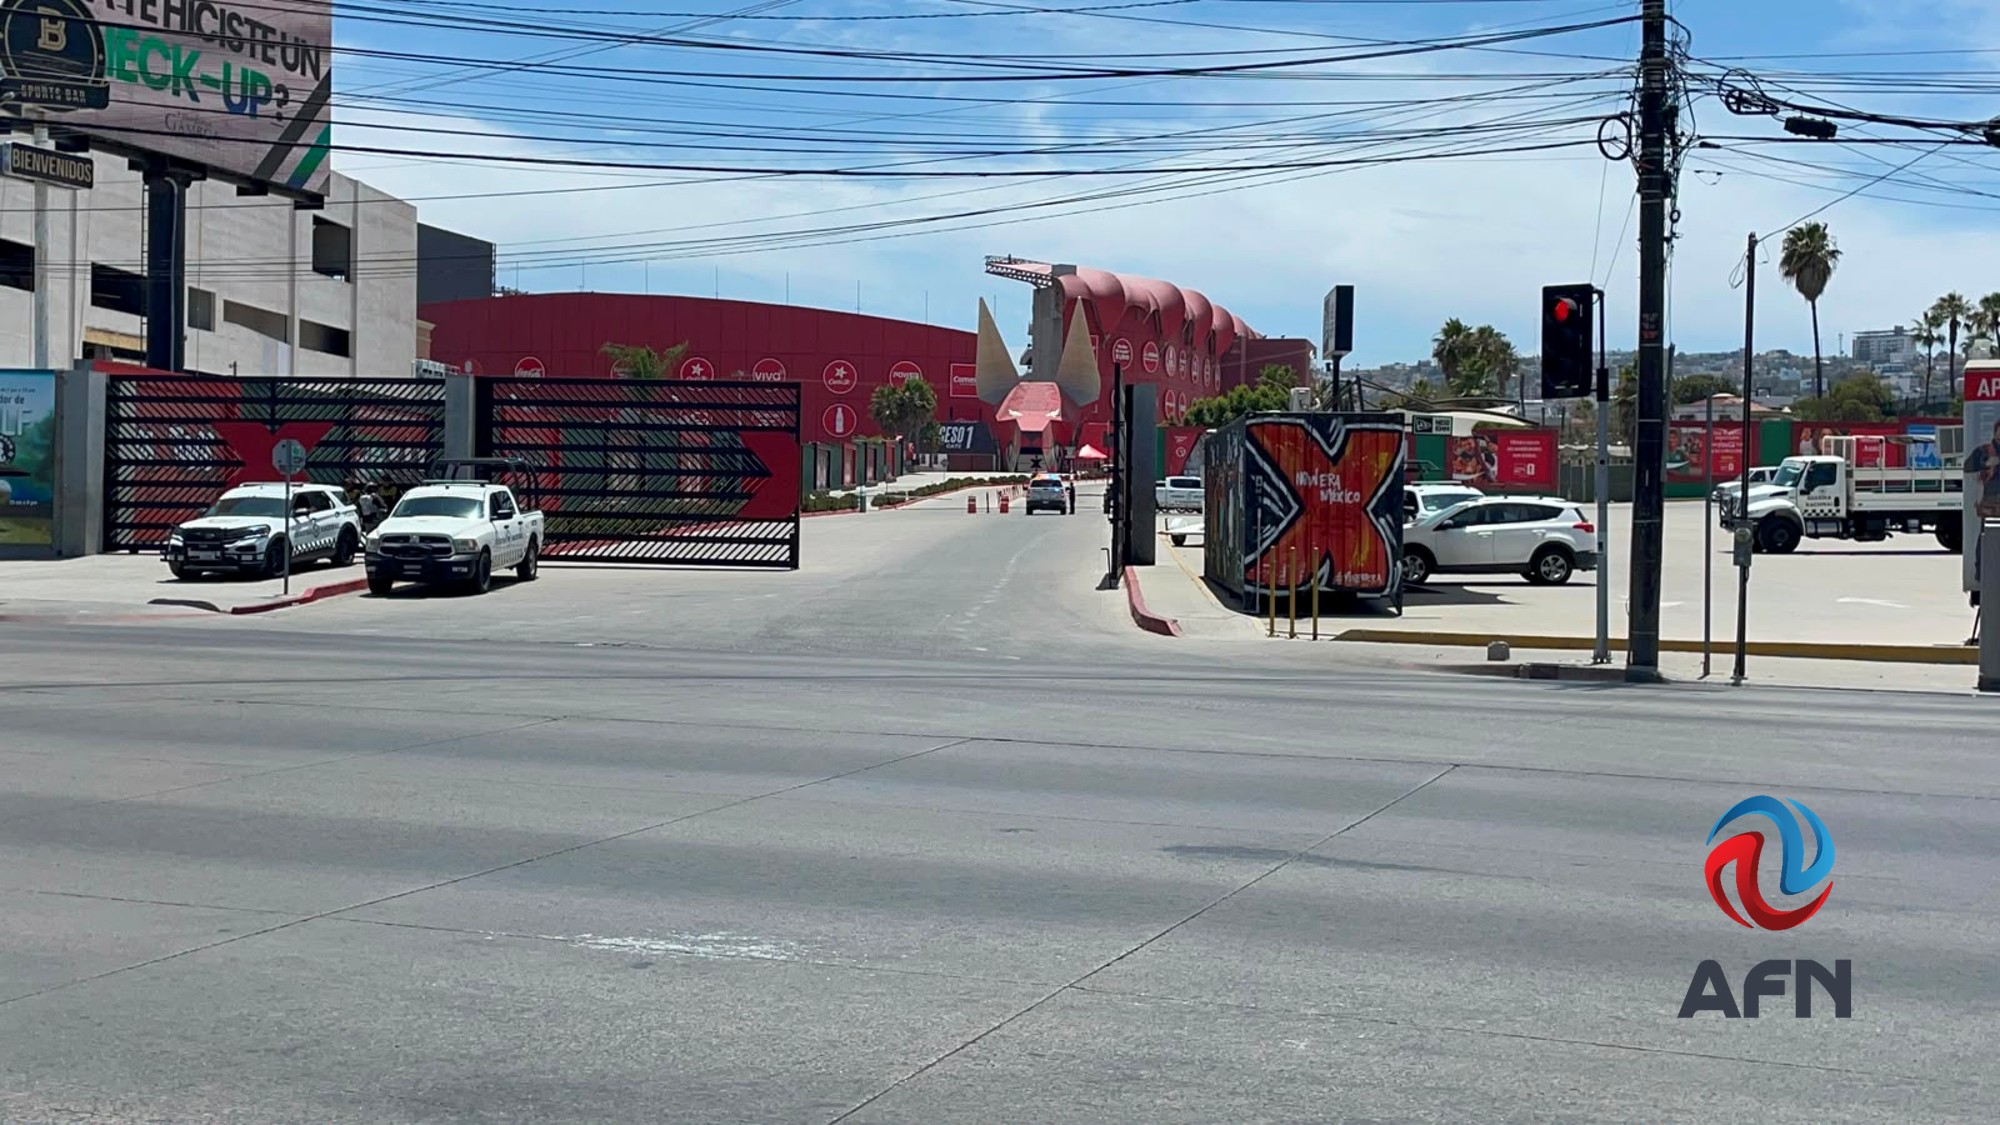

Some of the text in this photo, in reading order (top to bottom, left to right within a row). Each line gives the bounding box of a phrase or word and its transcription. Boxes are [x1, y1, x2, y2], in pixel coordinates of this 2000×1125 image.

[37, 6, 67, 51] B
[163, 0, 277, 66] HICISTE
[280, 31, 321, 81] UN
[20, 84, 86, 103] SPORTS BAR
[12, 148, 92, 183] BIENVENIDOS
[1977, 378, 2000, 397] AP
